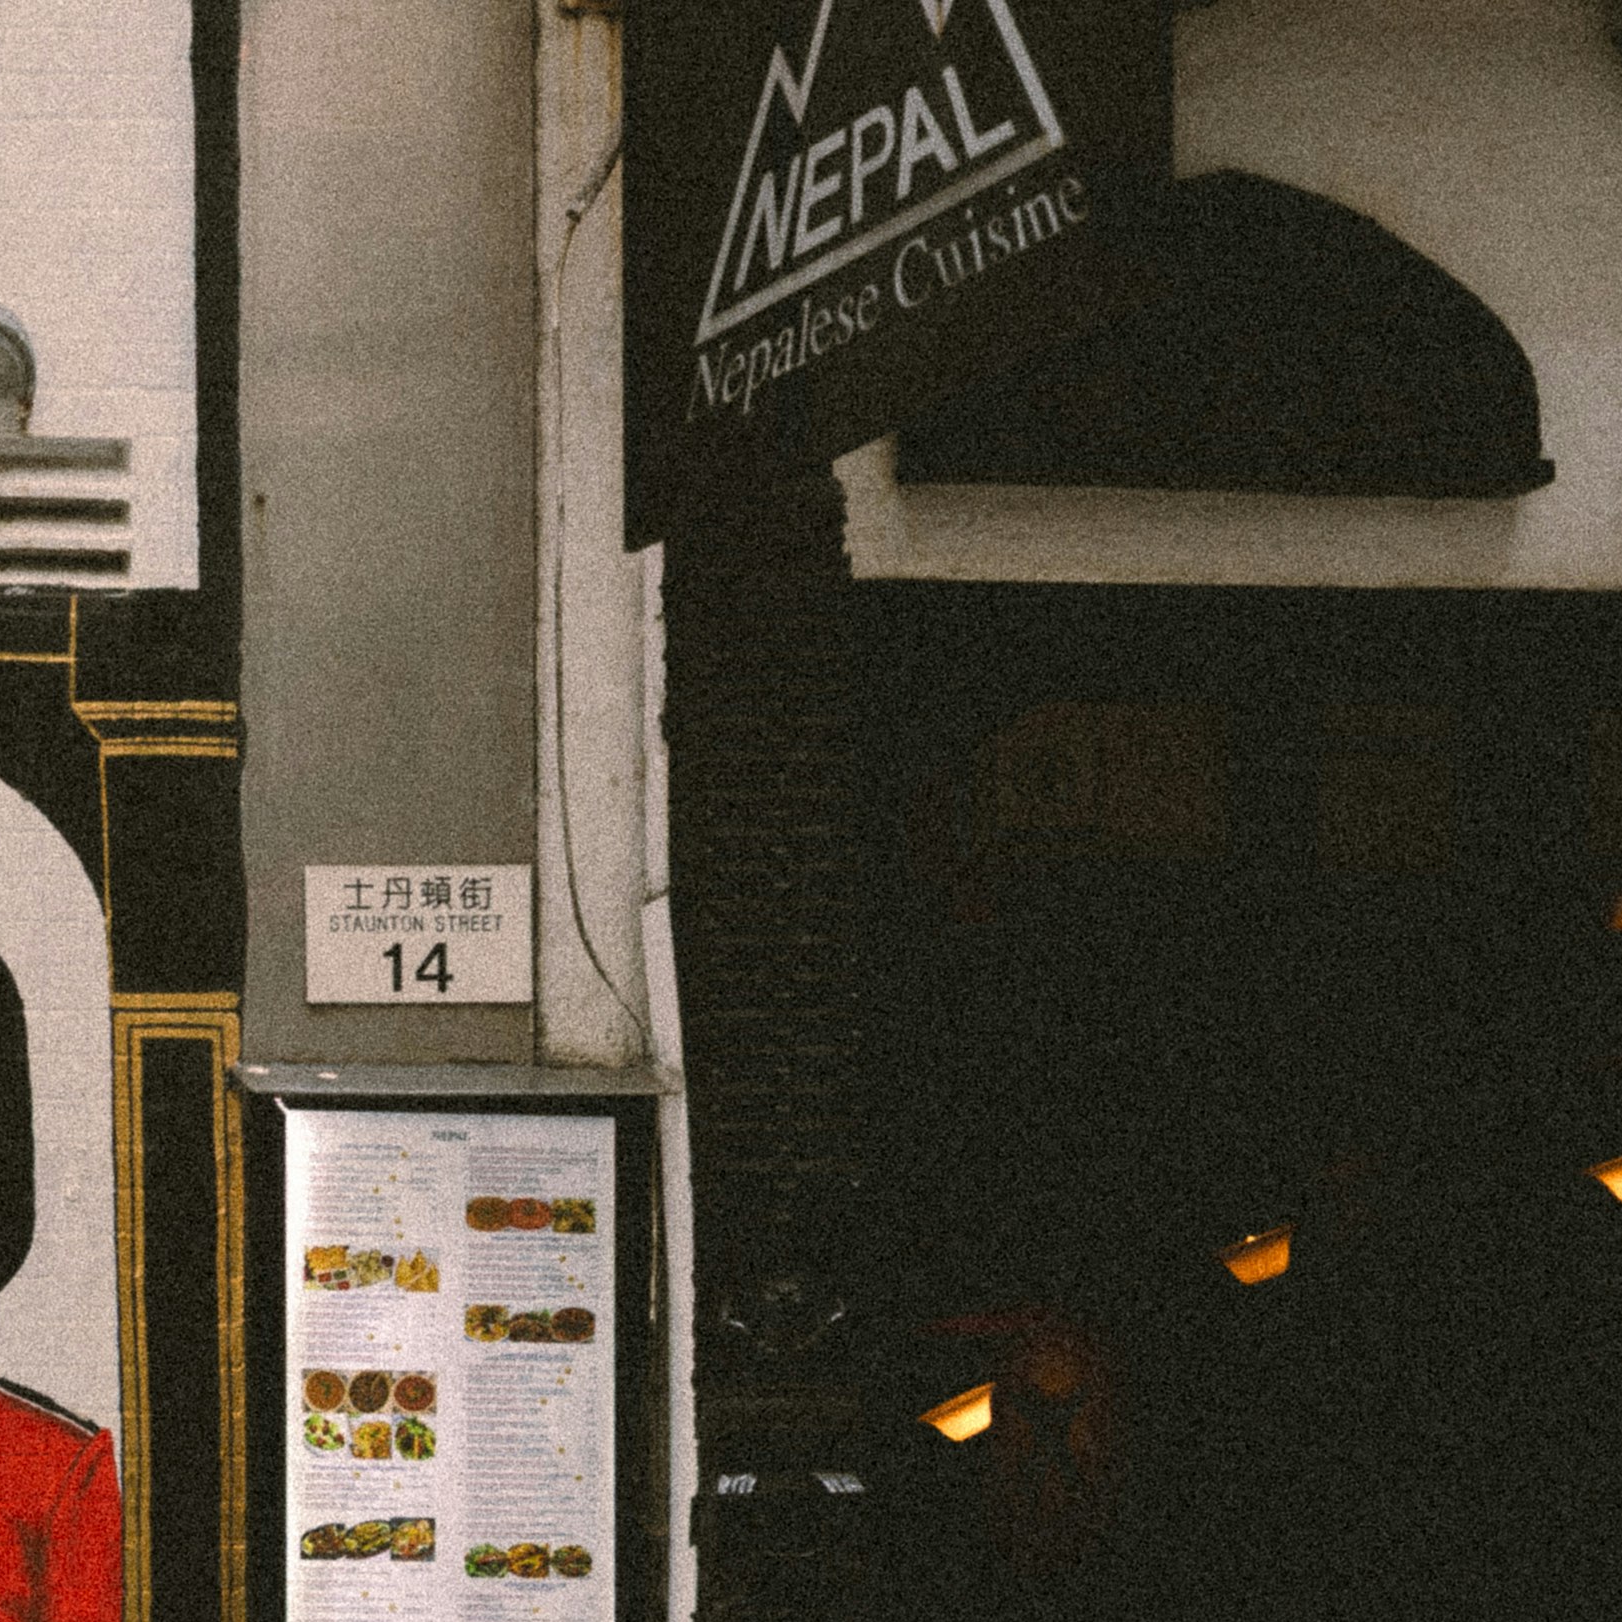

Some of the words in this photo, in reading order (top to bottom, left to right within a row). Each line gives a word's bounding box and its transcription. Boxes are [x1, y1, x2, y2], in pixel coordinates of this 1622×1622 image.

[732, 66, 1016, 291] NEPAL
[686, 280, 880, 423] Nepalese
[892, 175, 1091, 310] Cuisine
[343, 875, 493, 911] 士丹頓街
[328, 914, 425, 933] STAUNTON
[435, 914, 504, 933] STREET
[382, 942, 454, 993] 14
